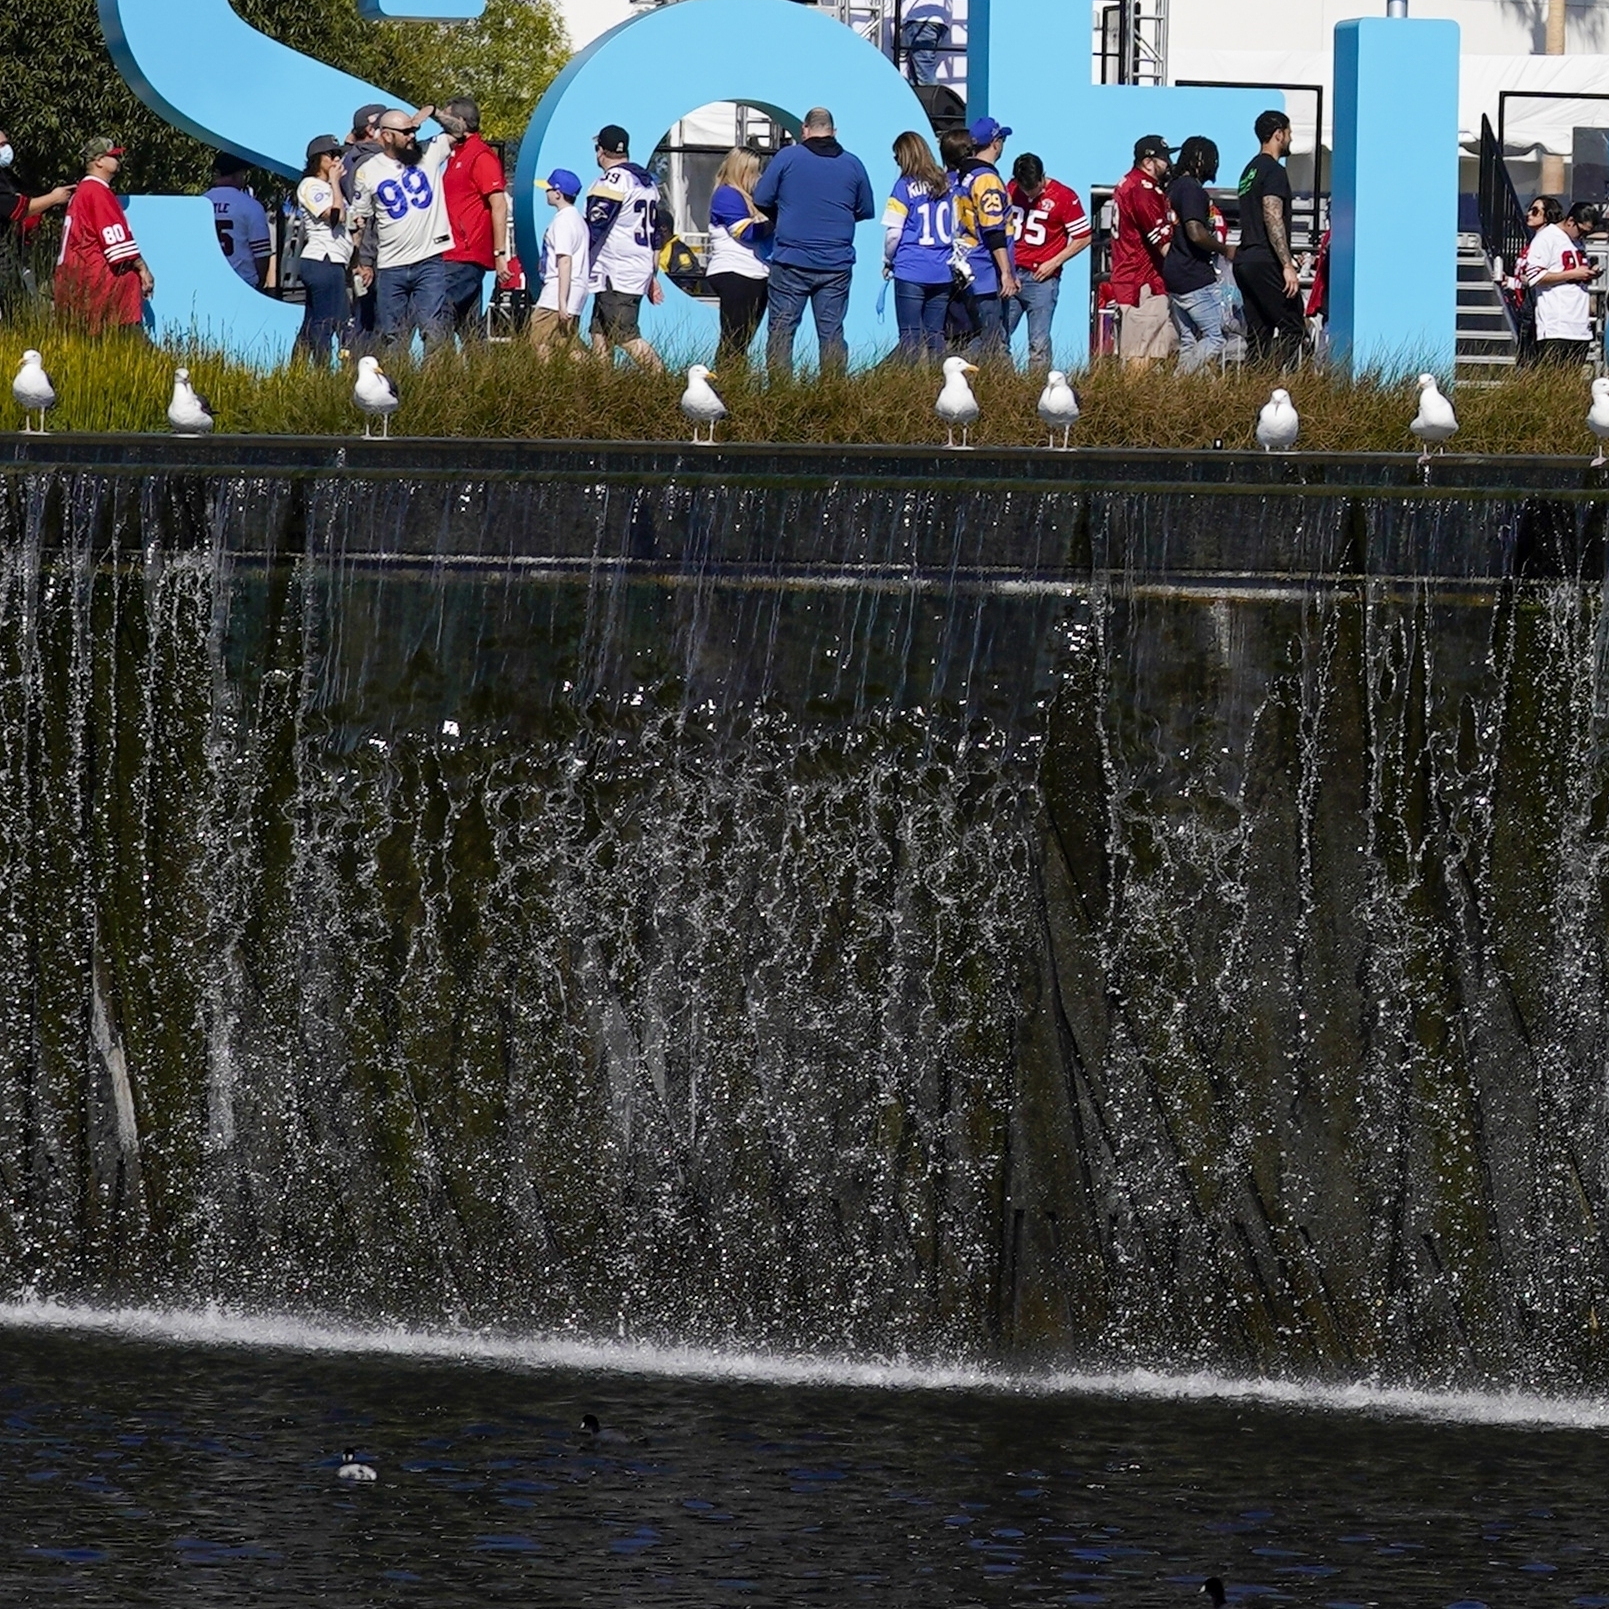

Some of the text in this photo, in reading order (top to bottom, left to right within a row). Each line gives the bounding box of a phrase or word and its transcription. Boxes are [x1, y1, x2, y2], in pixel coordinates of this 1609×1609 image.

[377, 164, 434, 221] 99
[908, 181, 937, 199] KUP
[102, 223, 126, 245] 80
[917, 200, 952, 247] 10
